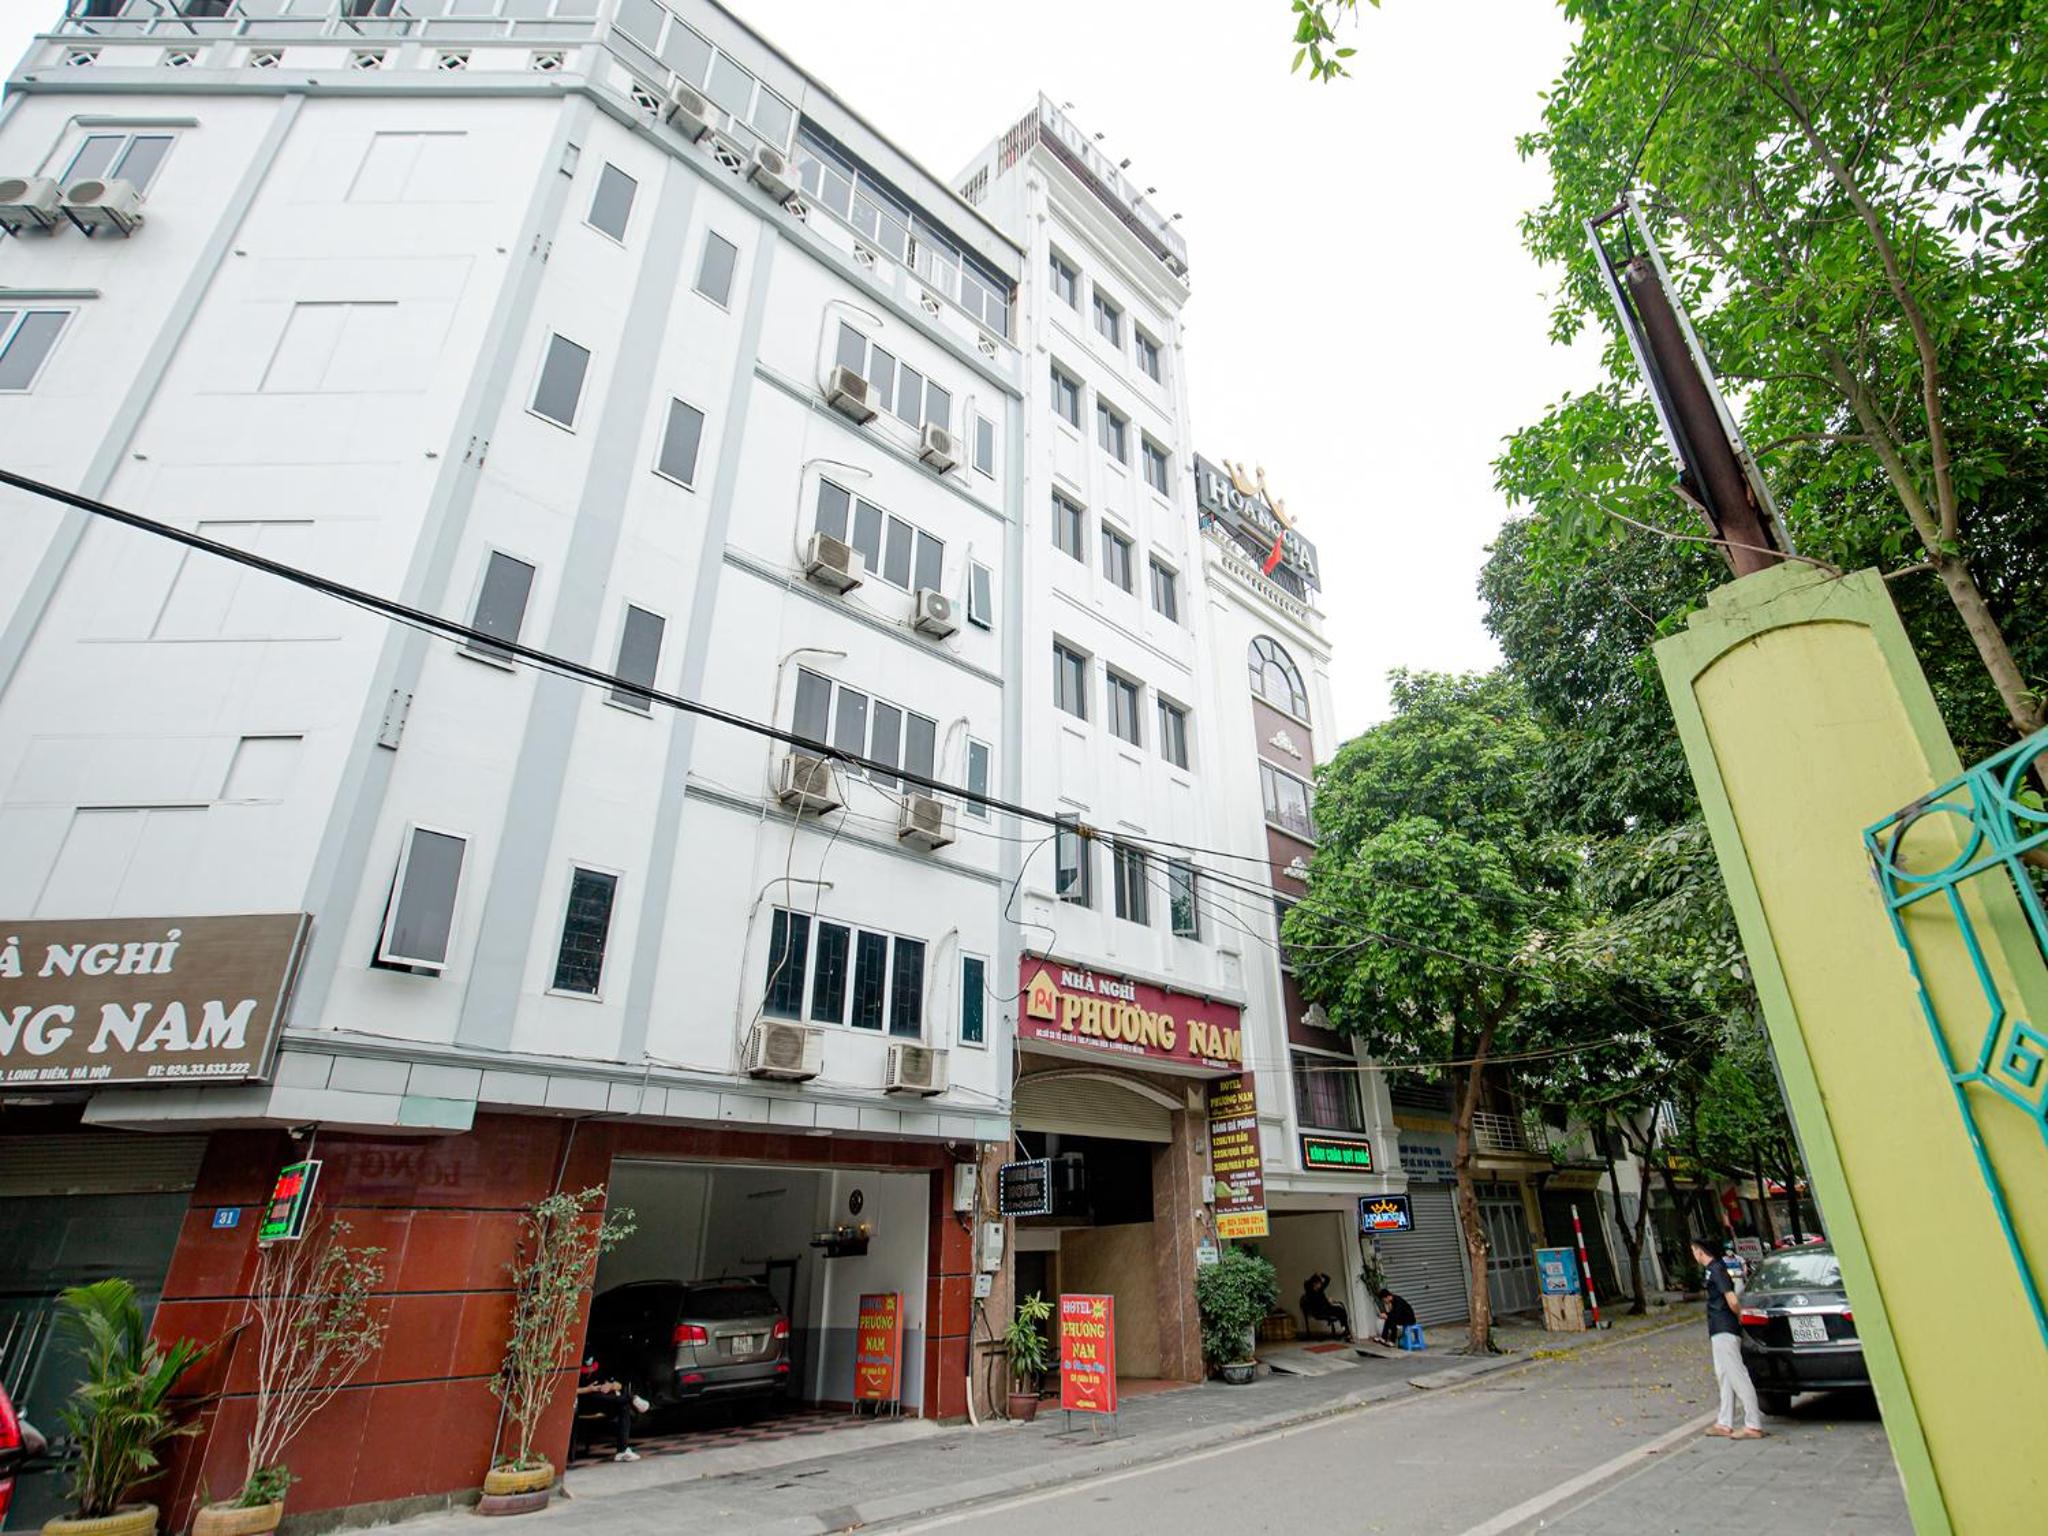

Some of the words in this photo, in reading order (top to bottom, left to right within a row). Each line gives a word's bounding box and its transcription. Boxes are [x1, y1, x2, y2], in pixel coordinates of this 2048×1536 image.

[38, 929, 182, 977] NGHỈ
[1061, 970, 1096, 993] NHÀ
[1099, 979, 1136, 1001] NGHỈ
[87, 999, 257, 1053] NAM
[1059, 993, 1176, 1050] PHƯƠNG
[1187, 1020, 1242, 1062] NAM
[6, 1069, 39, 1081] LONG
[1062, 1300, 1092, 1315] HOTEL
[1072, 1342, 1096, 1360] NAM
